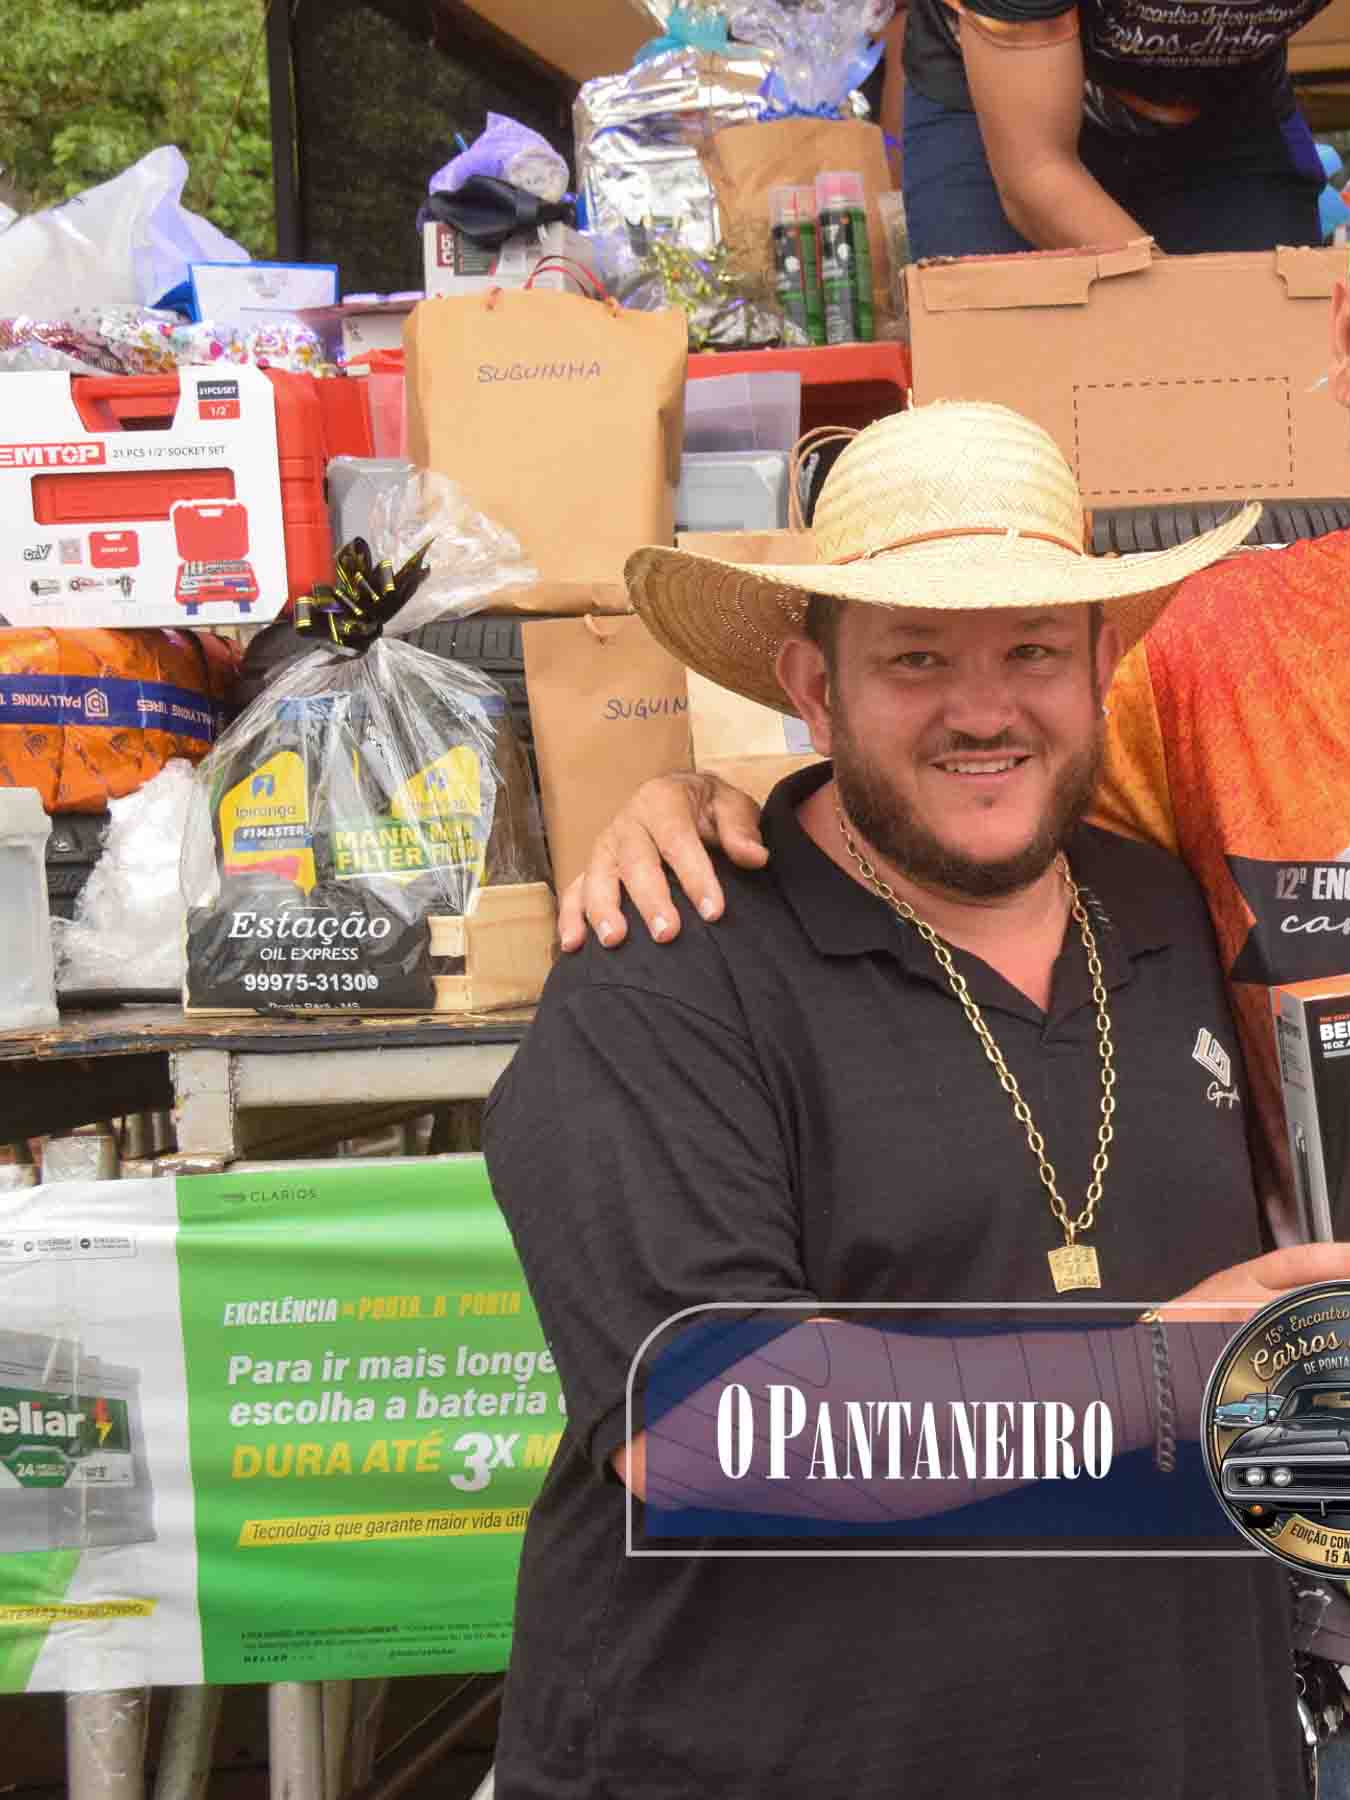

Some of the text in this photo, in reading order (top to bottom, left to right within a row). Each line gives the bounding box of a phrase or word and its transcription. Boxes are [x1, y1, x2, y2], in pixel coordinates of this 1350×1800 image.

[477, 362, 601, 384] SUGUINHA
[0, 446, 99, 466] EMTOP
[112, 448, 125, 459] 21
[127, 448, 145, 458] PCS
[168, 446, 207, 457] SOCKET
[208, 446, 226, 456] SET
[12, 692, 82, 709] PALLYKING
[604, 696, 689, 720] SUGUIN
[336, 826, 420, 849] MANN
[337, 847, 422, 870] FILTER
[228, 911, 392, 945] Estação
[259, 946, 360, 961] OIL EXPRESS
[250, 1188, 318, 1202] CLARIOS
[223, 1296, 338, 1327] EXCELÊNCIA
[227, 1355, 312, 1386] Para
[320, 1351, 350, 1382] ir
[358, 1347, 447, 1380] mais
[228, 1390, 375, 1426] escolha
[384, 1395, 406, 1419] a
[415, 1385, 547, 1420] bateria
[231, 1441, 353, 1479] DURA
[362, 1429, 444, 1476] ATÉ
[251, 1519, 330, 1542] Tecnologia
[334, 1520, 361, 1539] que
[365, 1518, 424, 1538] garante
[425, 1512, 467, 1531] maior
[471, 1511, 502, 1529] vida
